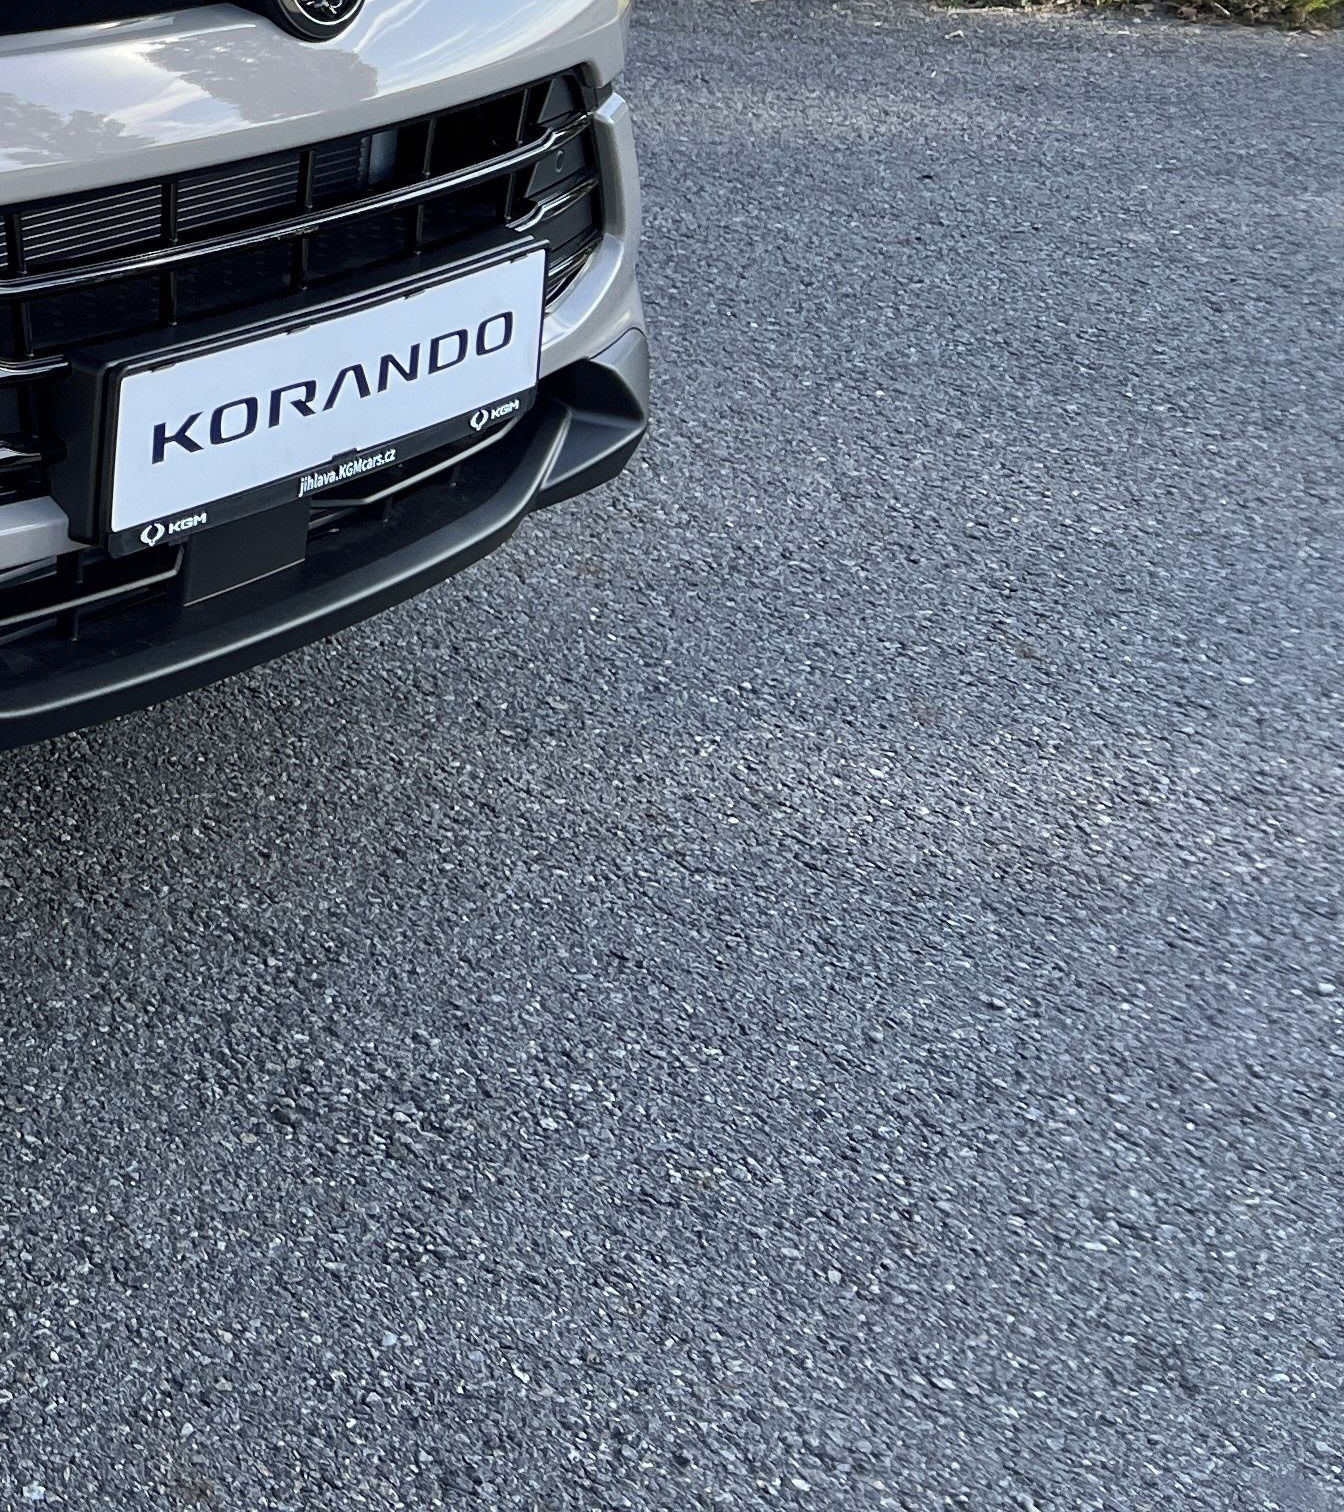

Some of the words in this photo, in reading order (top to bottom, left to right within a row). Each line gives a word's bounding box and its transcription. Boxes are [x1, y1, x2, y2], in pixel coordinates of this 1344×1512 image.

[151, 311, 514, 465] KORANDO
[490, 399, 520, 420] KGM
[297, 448, 396, 497] jihlava.KGMcars.cz
[168, 512, 207, 536] KGM
